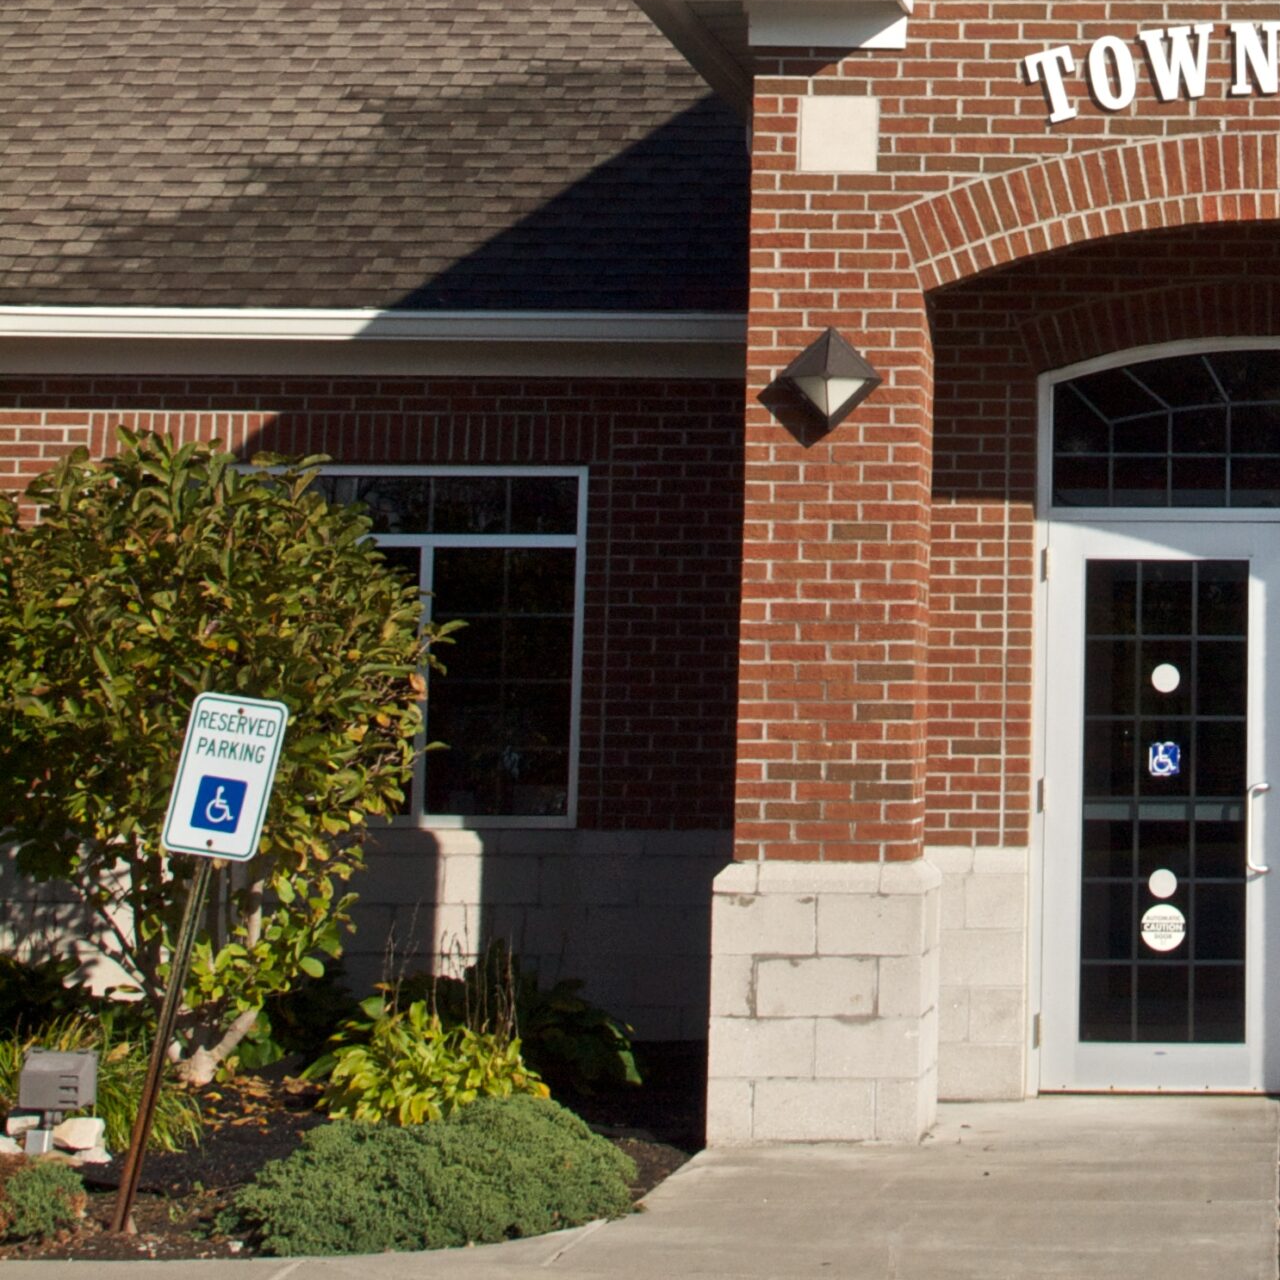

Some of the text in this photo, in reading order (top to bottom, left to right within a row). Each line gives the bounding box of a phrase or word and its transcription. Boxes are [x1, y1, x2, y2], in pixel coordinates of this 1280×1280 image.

[197, 710, 277, 738] RESERVED
[196, 737, 266, 764] PARKING
[1144, 923, 1183, 931] CAUTION
